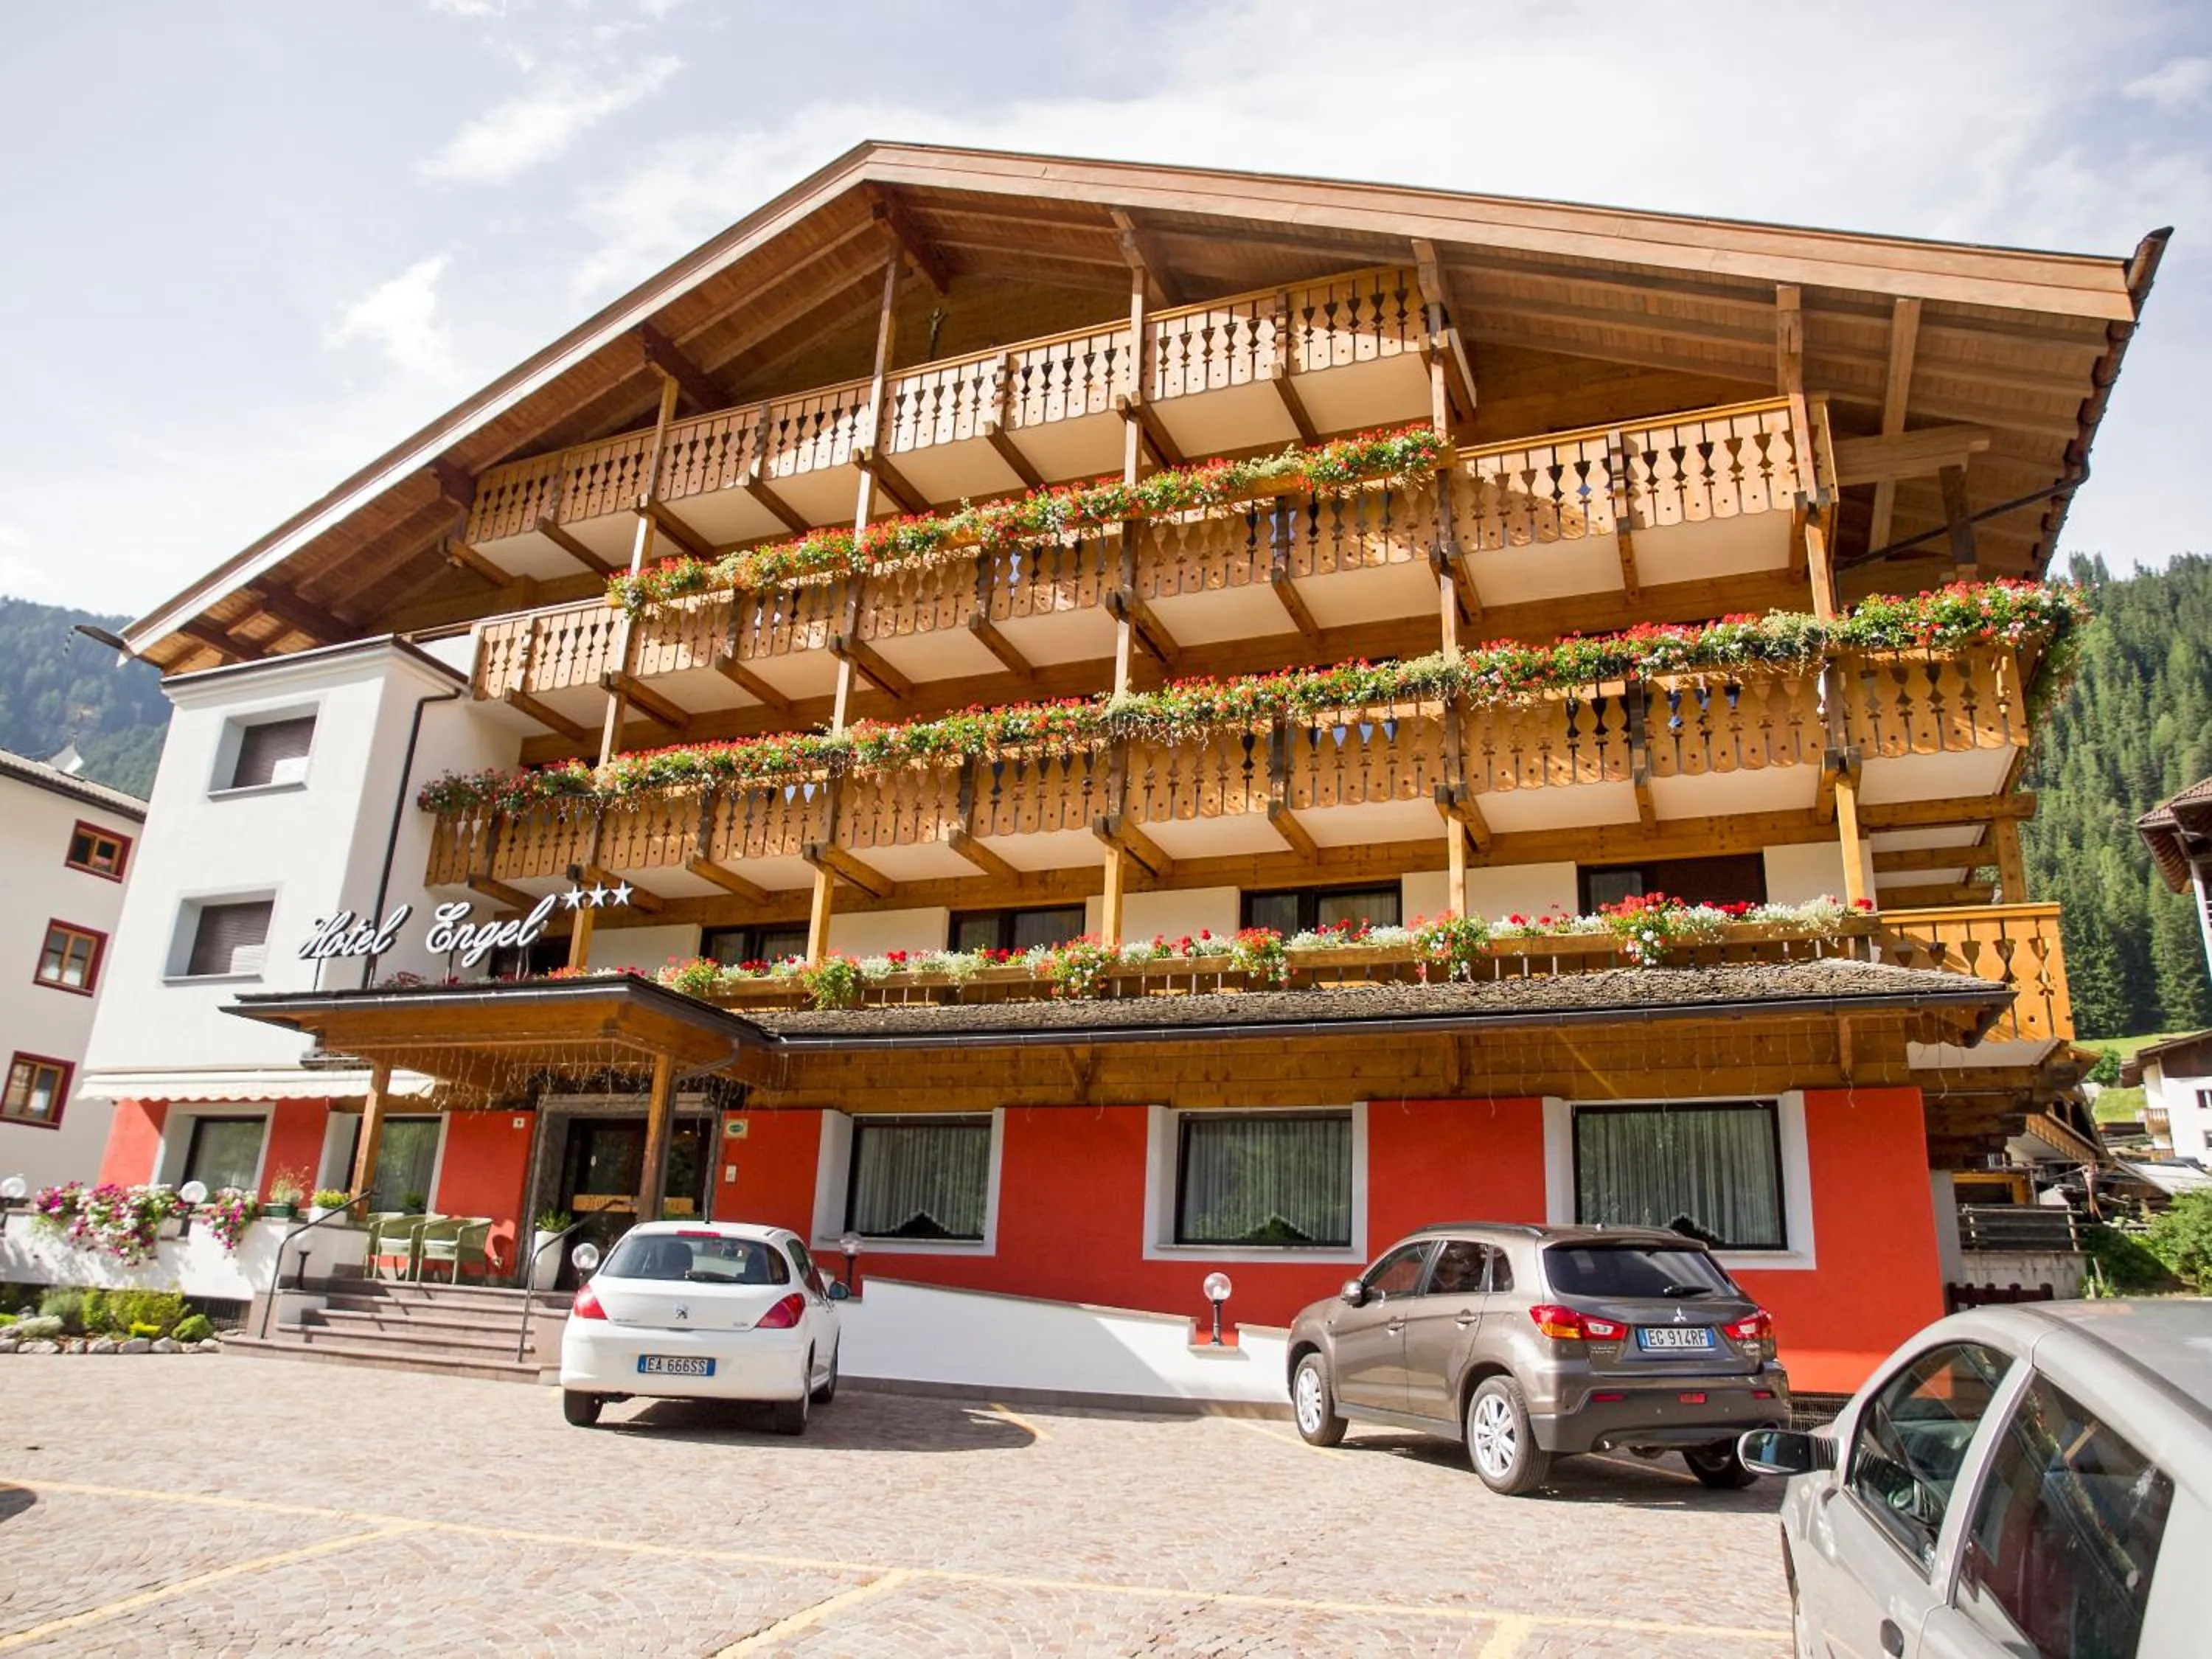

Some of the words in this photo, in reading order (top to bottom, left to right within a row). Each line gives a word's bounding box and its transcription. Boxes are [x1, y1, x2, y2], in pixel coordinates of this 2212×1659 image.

[299, 903, 414, 960] Hotel
[425, 893, 557, 969] Engel
[1649, 1329, 1664, 1346] EG
[1667, 1329, 1705, 1346] 914RF
[647, 1357, 661, 1371] EA
[667, 1359, 706, 1373] 666SS
